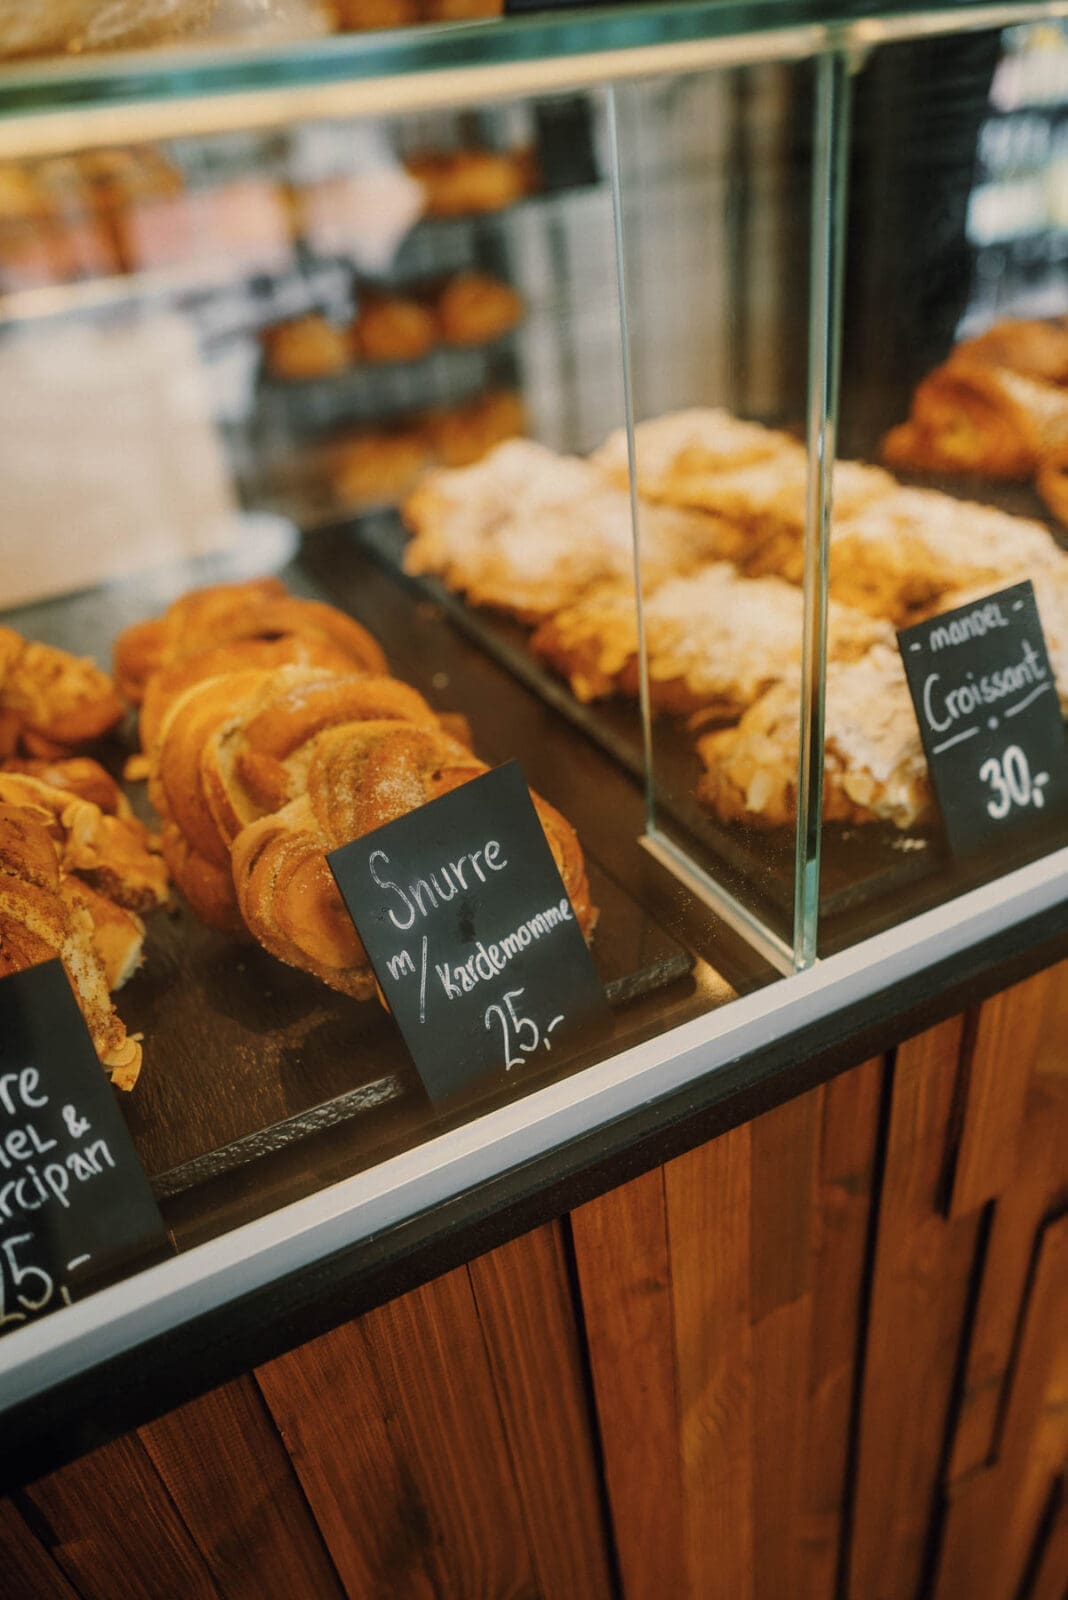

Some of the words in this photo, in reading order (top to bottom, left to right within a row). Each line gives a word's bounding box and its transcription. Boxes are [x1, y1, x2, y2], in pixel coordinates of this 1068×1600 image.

[924, 639, 1046, 732] Croissant
[368, 840, 508, 930] Snurre
[435, 898, 573, 999] Kardemomme
[485, 988, 564, 1071] 25,-
[62, 1104, 91, 1138] &
